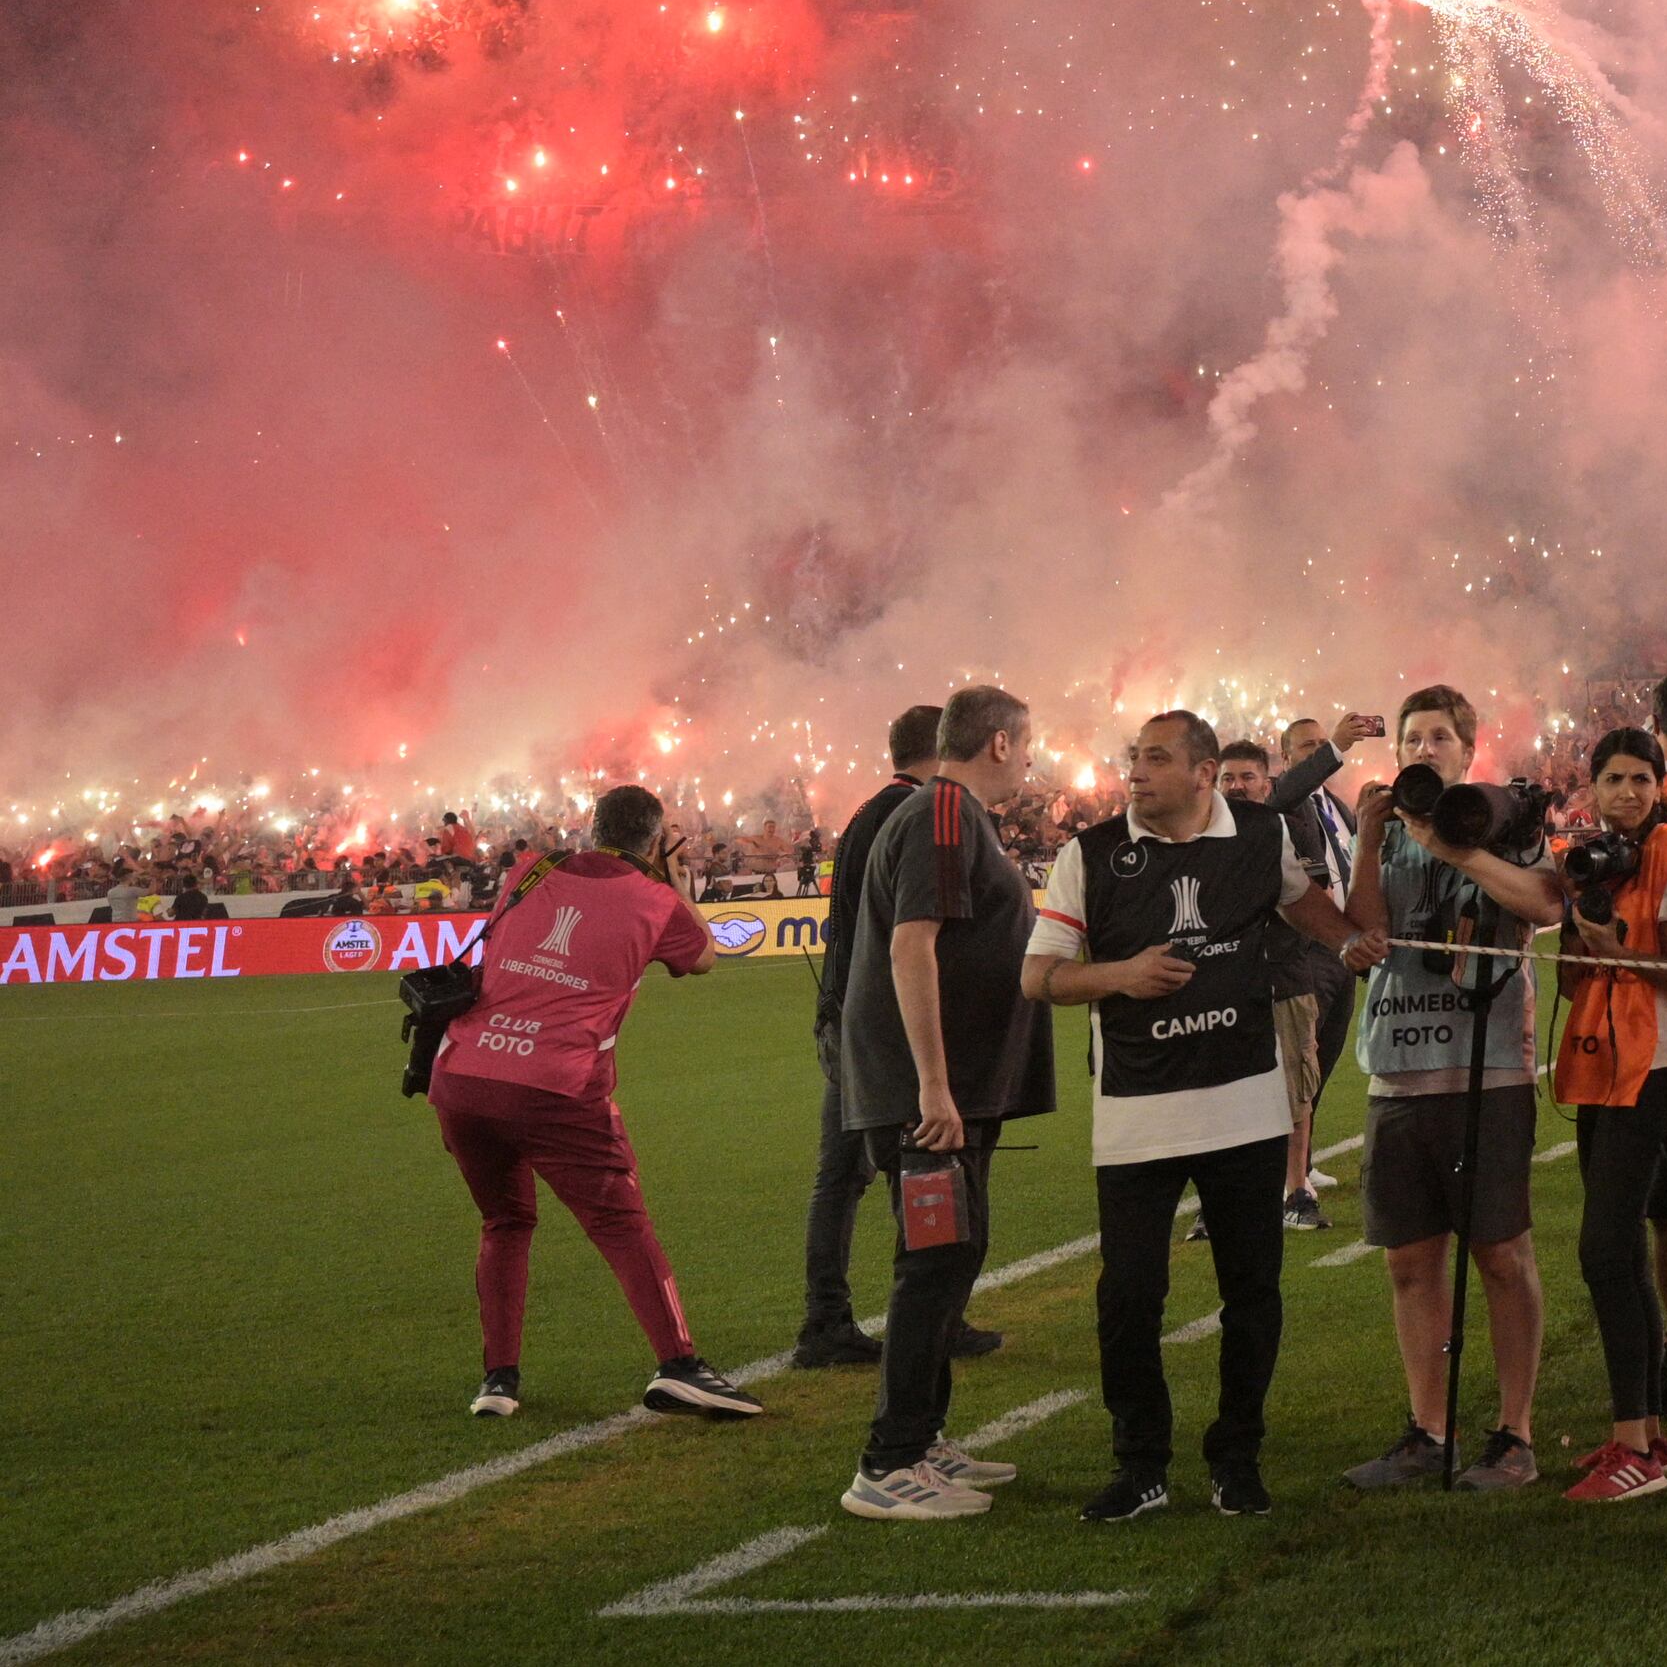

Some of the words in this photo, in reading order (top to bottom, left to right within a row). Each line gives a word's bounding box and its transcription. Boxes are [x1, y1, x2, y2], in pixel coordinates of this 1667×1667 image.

[0, 926, 242, 984] AMSTEL
[335, 938, 371, 950] AMSTEL
[499, 958, 589, 992] LIBERTADORES
[1371, 993, 1473, 1017] CONMEBO
[489, 1013, 543, 1035] CLUB
[1151, 1007, 1238, 1040] CAMPO
[477, 1031, 535, 1057] FOTO
[1392, 1025, 1453, 1048] FOTO
